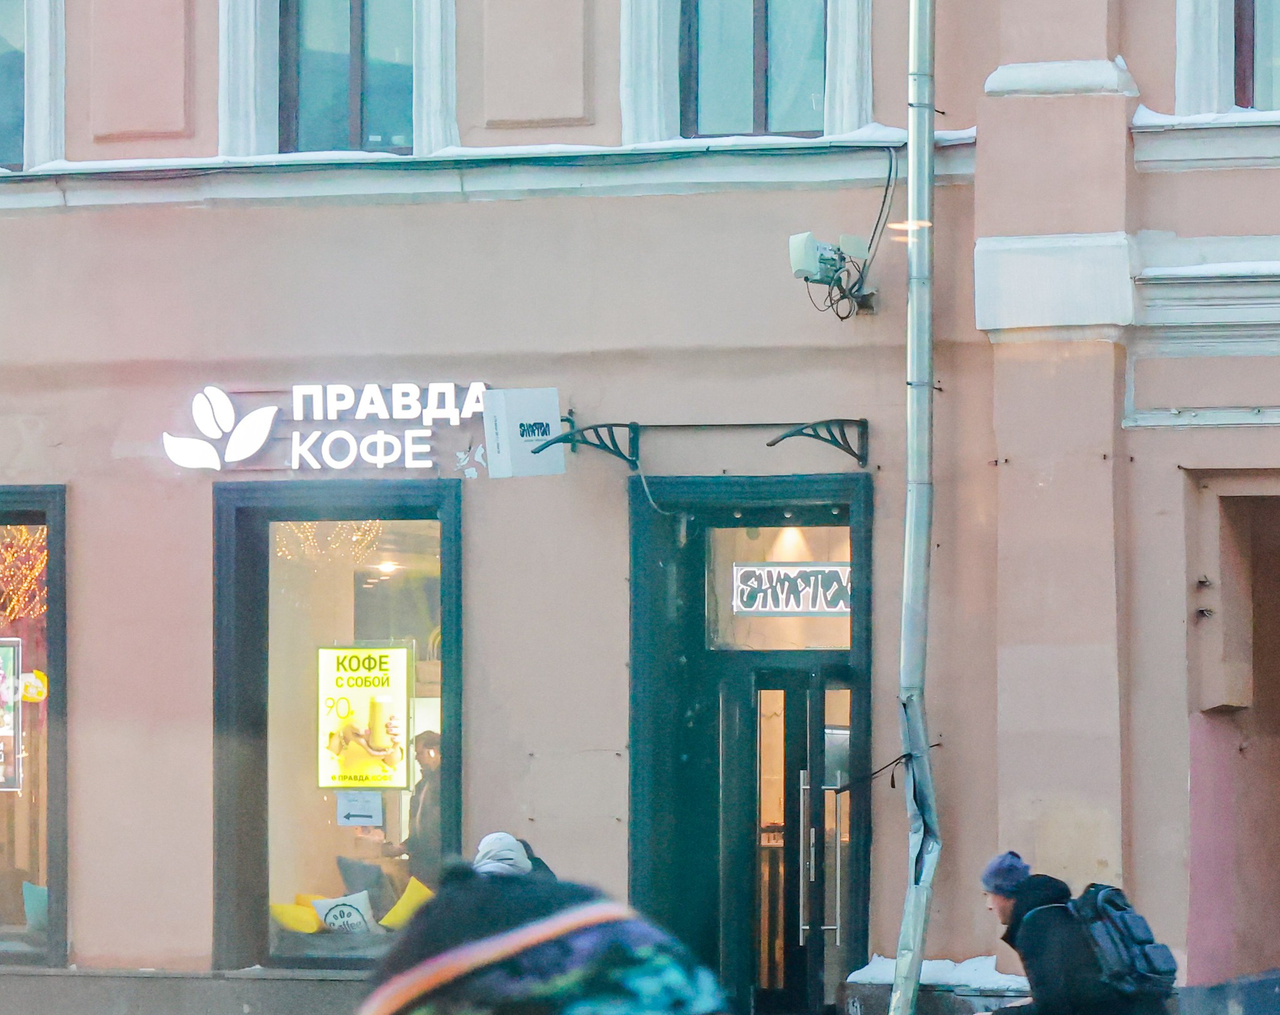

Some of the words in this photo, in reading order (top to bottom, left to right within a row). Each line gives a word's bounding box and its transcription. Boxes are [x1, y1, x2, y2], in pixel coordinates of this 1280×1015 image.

[293, 382, 486, 426] ПРАВДА
[291, 430, 433, 470] КОФЕ
[336, 654, 389, 673] КОФЕ
[335, 676, 344, 688] С
[346, 673, 390, 688] СОБОЙ
[338, 774, 370, 783] ПРАВДА
